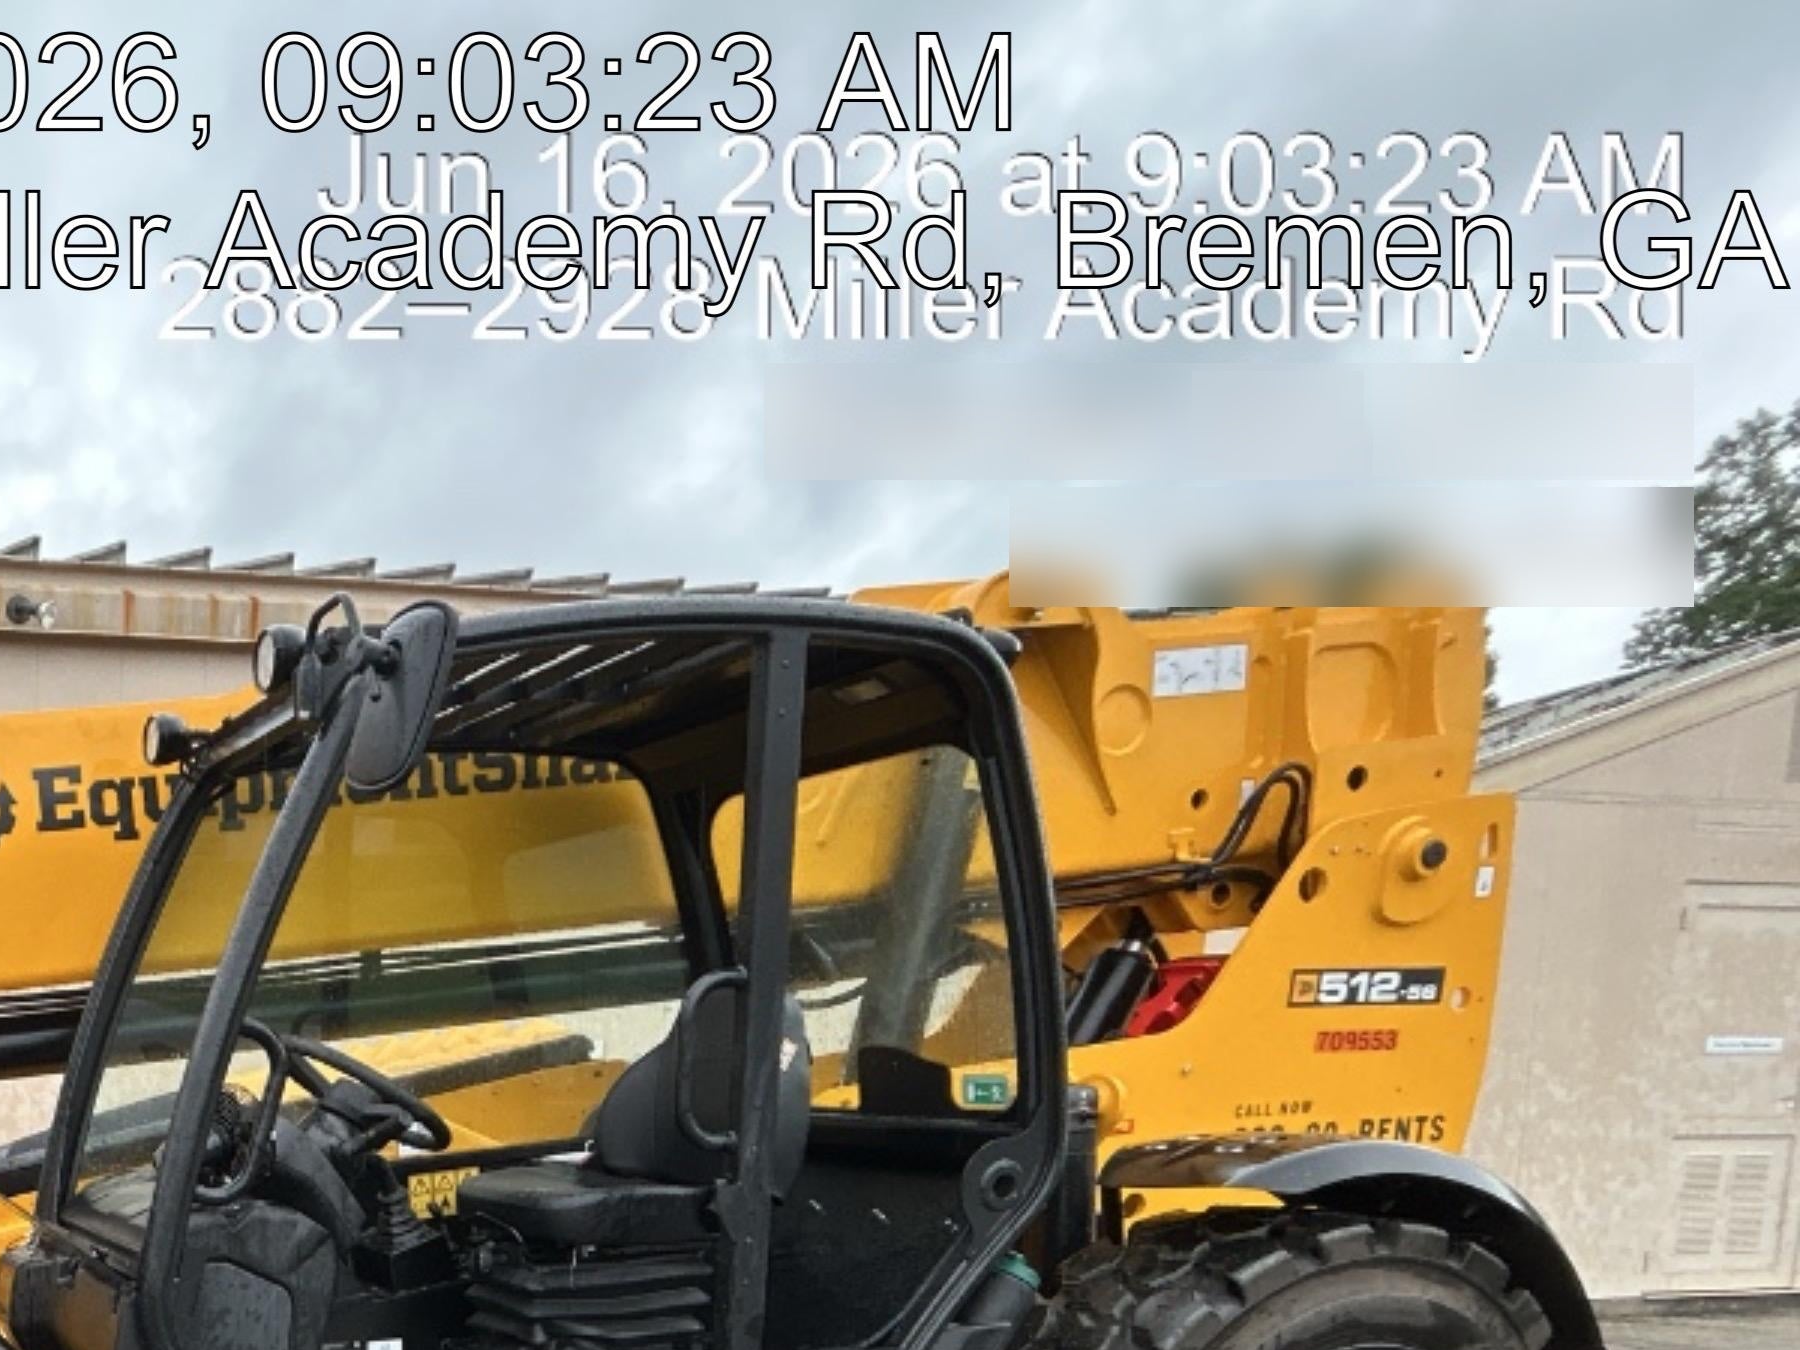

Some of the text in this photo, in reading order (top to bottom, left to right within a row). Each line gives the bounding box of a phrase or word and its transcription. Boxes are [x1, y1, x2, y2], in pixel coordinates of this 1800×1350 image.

[1315, 1030, 1398, 1052] 709553
[1235, 1100, 1313, 1118] CALL NOW
